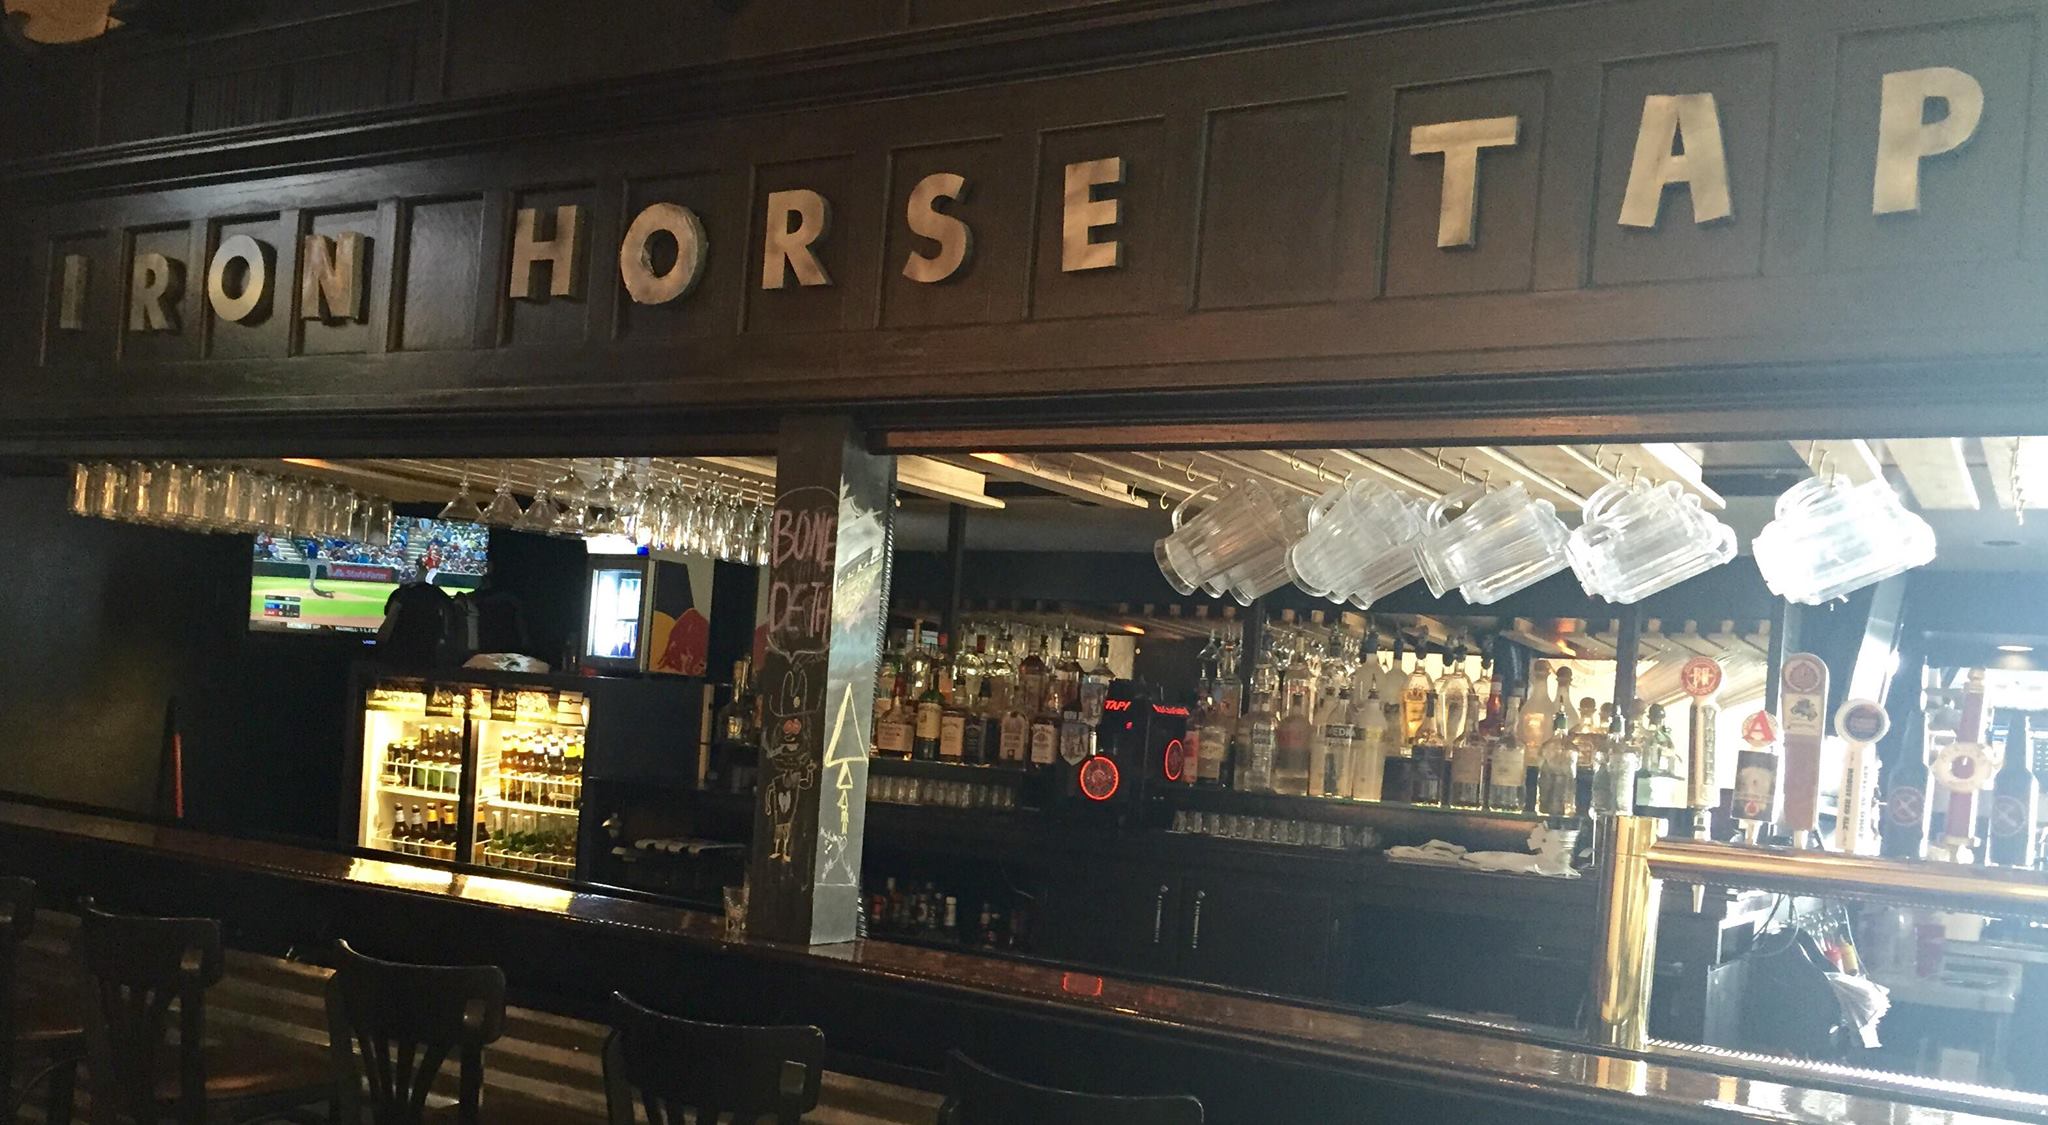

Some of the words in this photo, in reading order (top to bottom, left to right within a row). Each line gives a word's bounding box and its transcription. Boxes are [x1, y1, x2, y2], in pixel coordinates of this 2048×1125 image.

[59, 231, 366, 333] IRON
[509, 156, 1126, 306] HORSE
[1410, 66, 1986, 249] TAP
[773, 508, 836, 572] BONE
